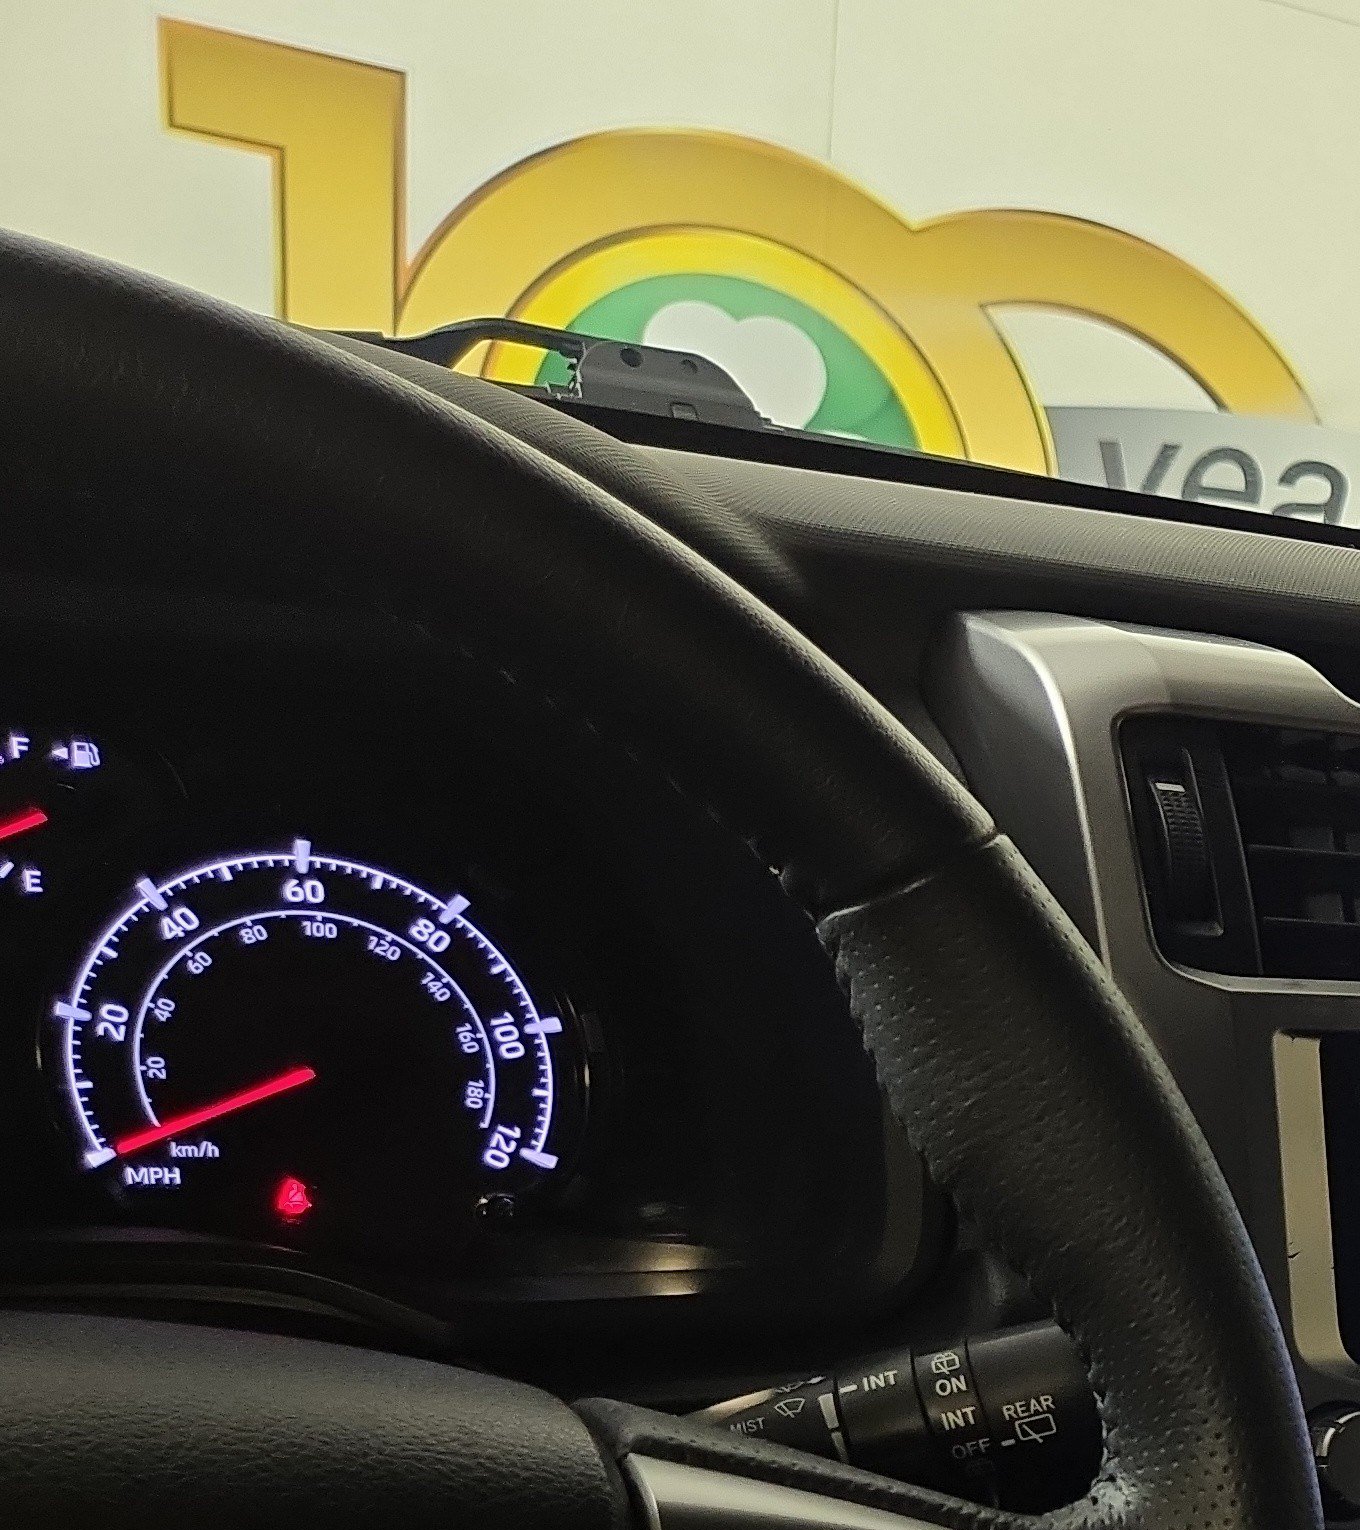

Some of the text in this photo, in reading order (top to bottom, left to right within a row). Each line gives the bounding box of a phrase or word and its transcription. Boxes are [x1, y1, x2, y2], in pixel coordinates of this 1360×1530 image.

[11, 736, 30, 759] F
[24, 869, 43, 893] E
[283, 880, 325, 903] 60
[160, 906, 200, 940] 40
[239, 923, 269, 945] 80
[301, 920, 338, 940] 100
[366, 933, 403, 962] 120
[406, 917, 452, 954] 80
[186, 951, 213, 976] 60
[420, 971, 452, 1002] 140
[97, 1002, 129, 1042] 20
[153, 998, 176, 1022] 40
[454, 1021, 480, 1054] 160
[489, 1011, 525, 1060] 100
[147, 1056, 167, 1080] 20
[464, 1078, 486, 1110] 180
[169, 1142, 219, 1160] km/h
[482, 1124, 522, 1169] 120
[125, 1167, 181, 1186] MPH
[863, 1370, 898, 1391] INT
[935, 1376, 967, 1397] ON
[940, 1406, 977, 1431] INT
[1003, 1395, 1057, 1421] REAR
[952, 1437, 992, 1461] OFF
